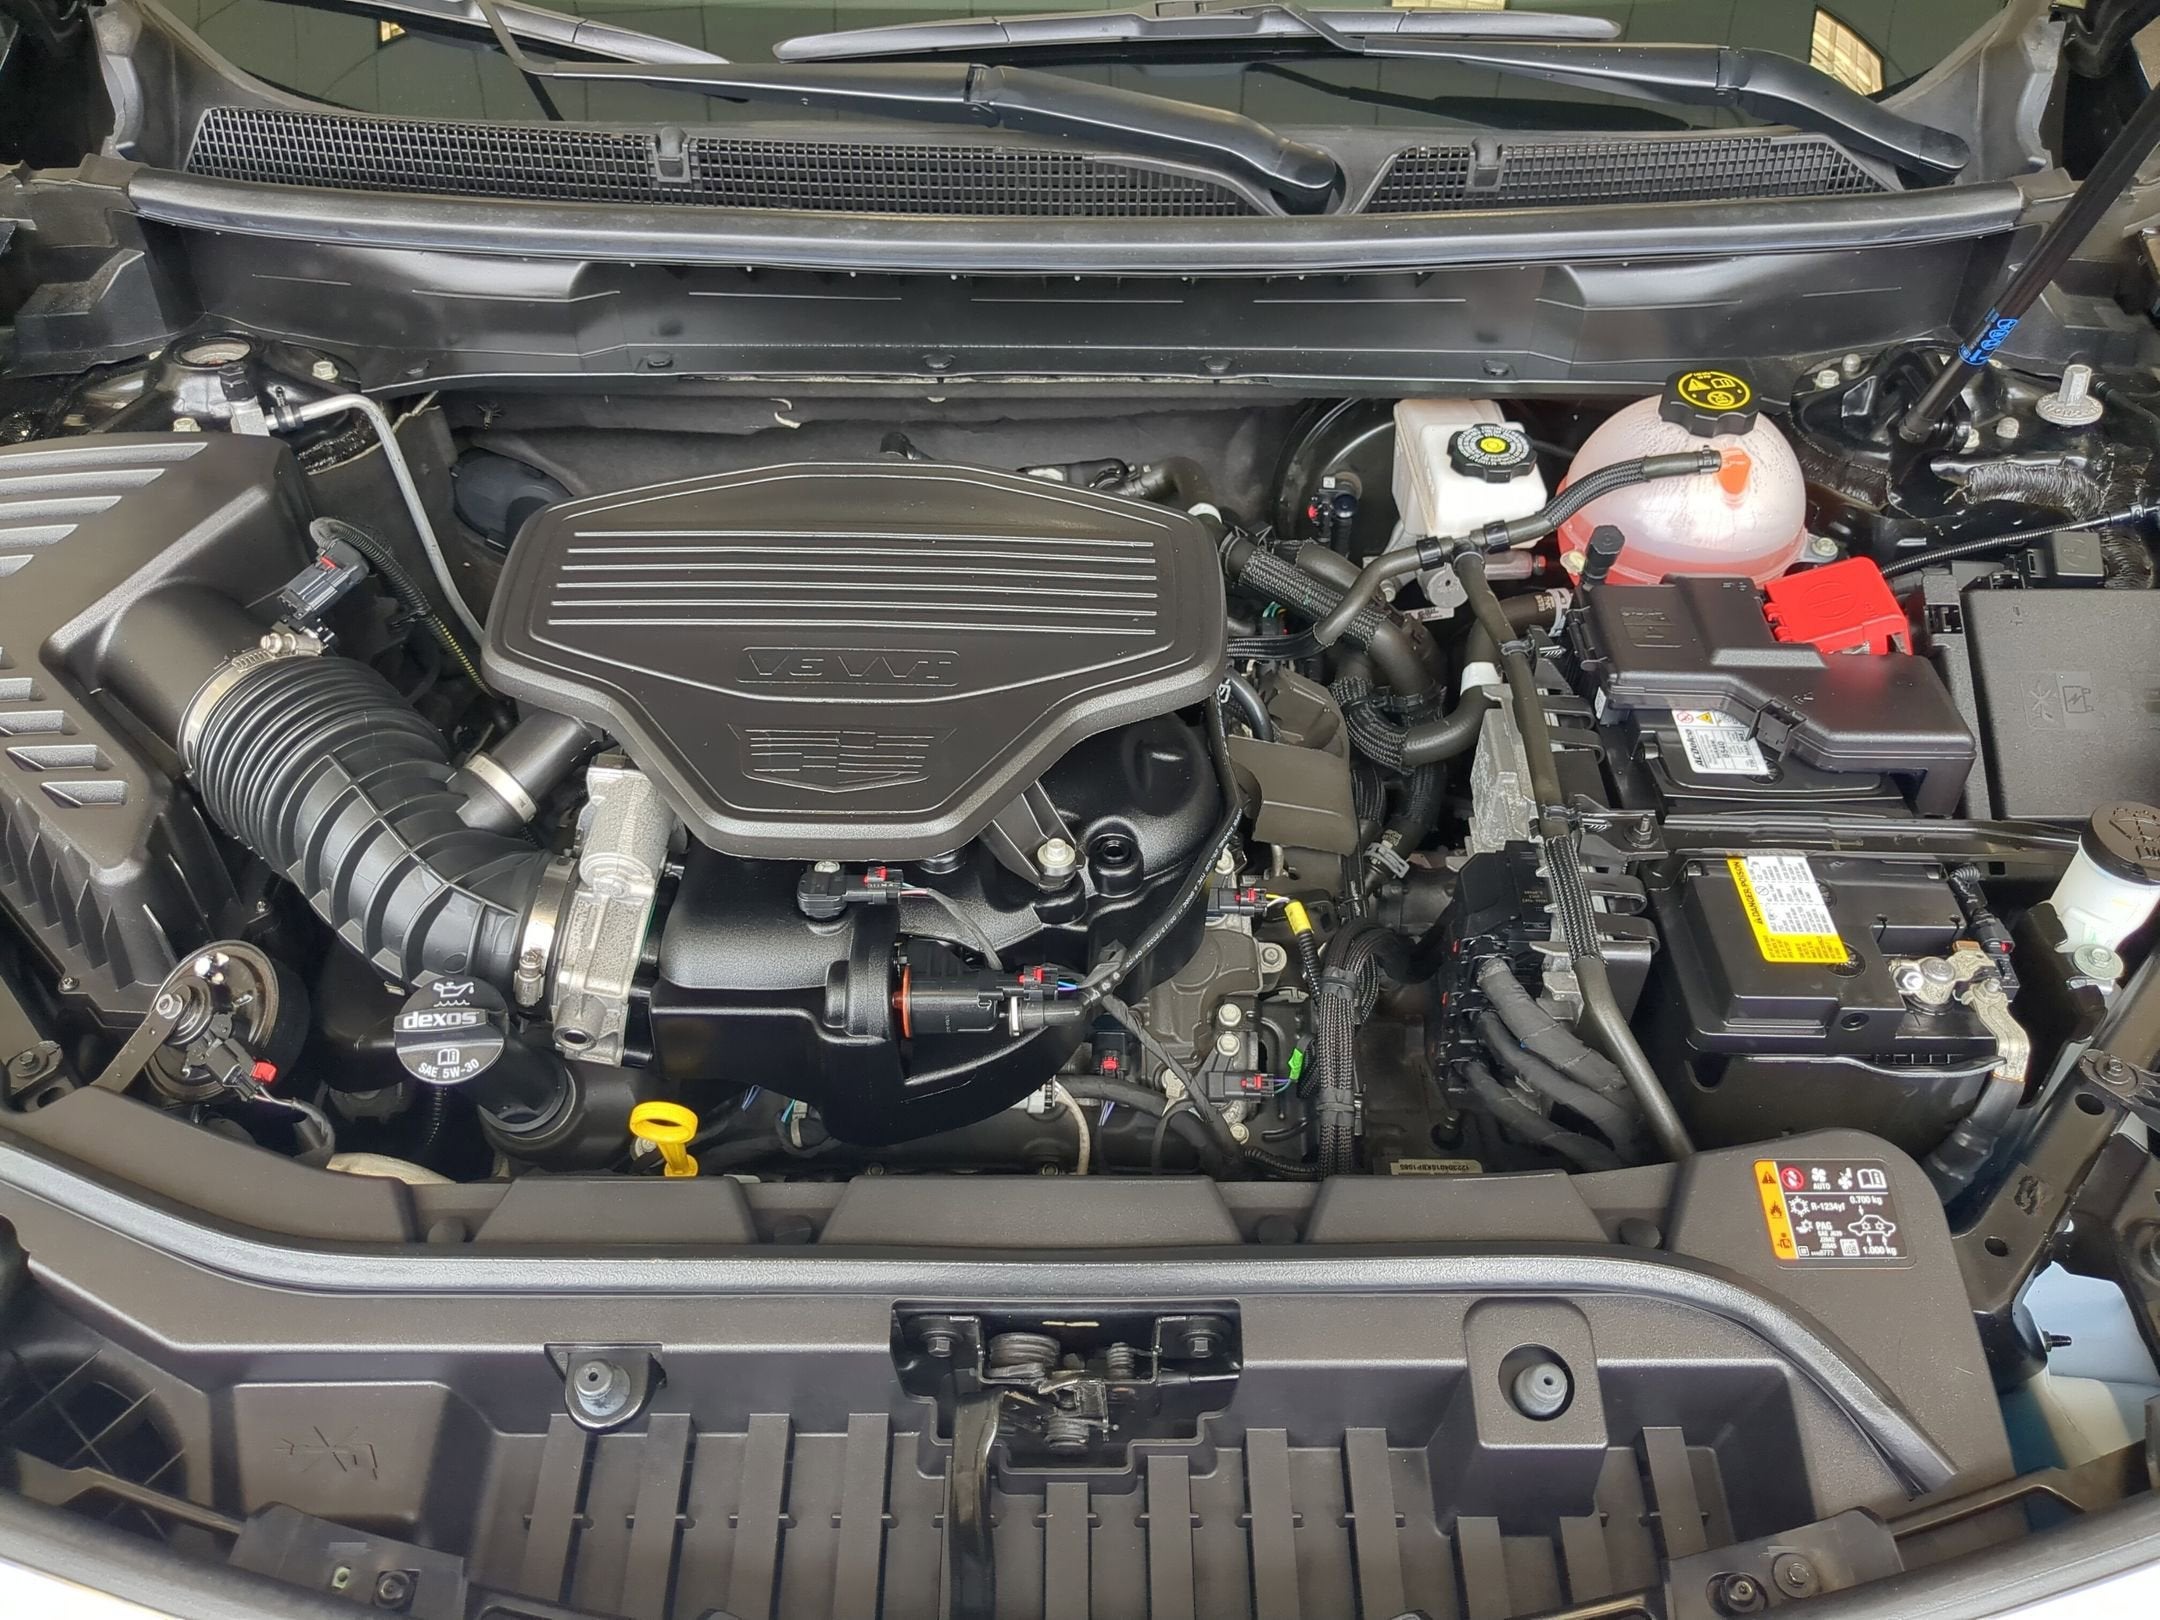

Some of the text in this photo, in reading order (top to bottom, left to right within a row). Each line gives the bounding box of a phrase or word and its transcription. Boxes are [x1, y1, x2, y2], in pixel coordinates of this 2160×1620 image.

[403, 1011, 477, 1029] dexos
[418, 1058, 479, 1079] SAE 5W-30
[1849, 1195, 1883, 1205] 0.700 kg
[1815, 1221, 1833, 1230] PAG
[1862, 1246, 1897, 1256] 1.000 kg
